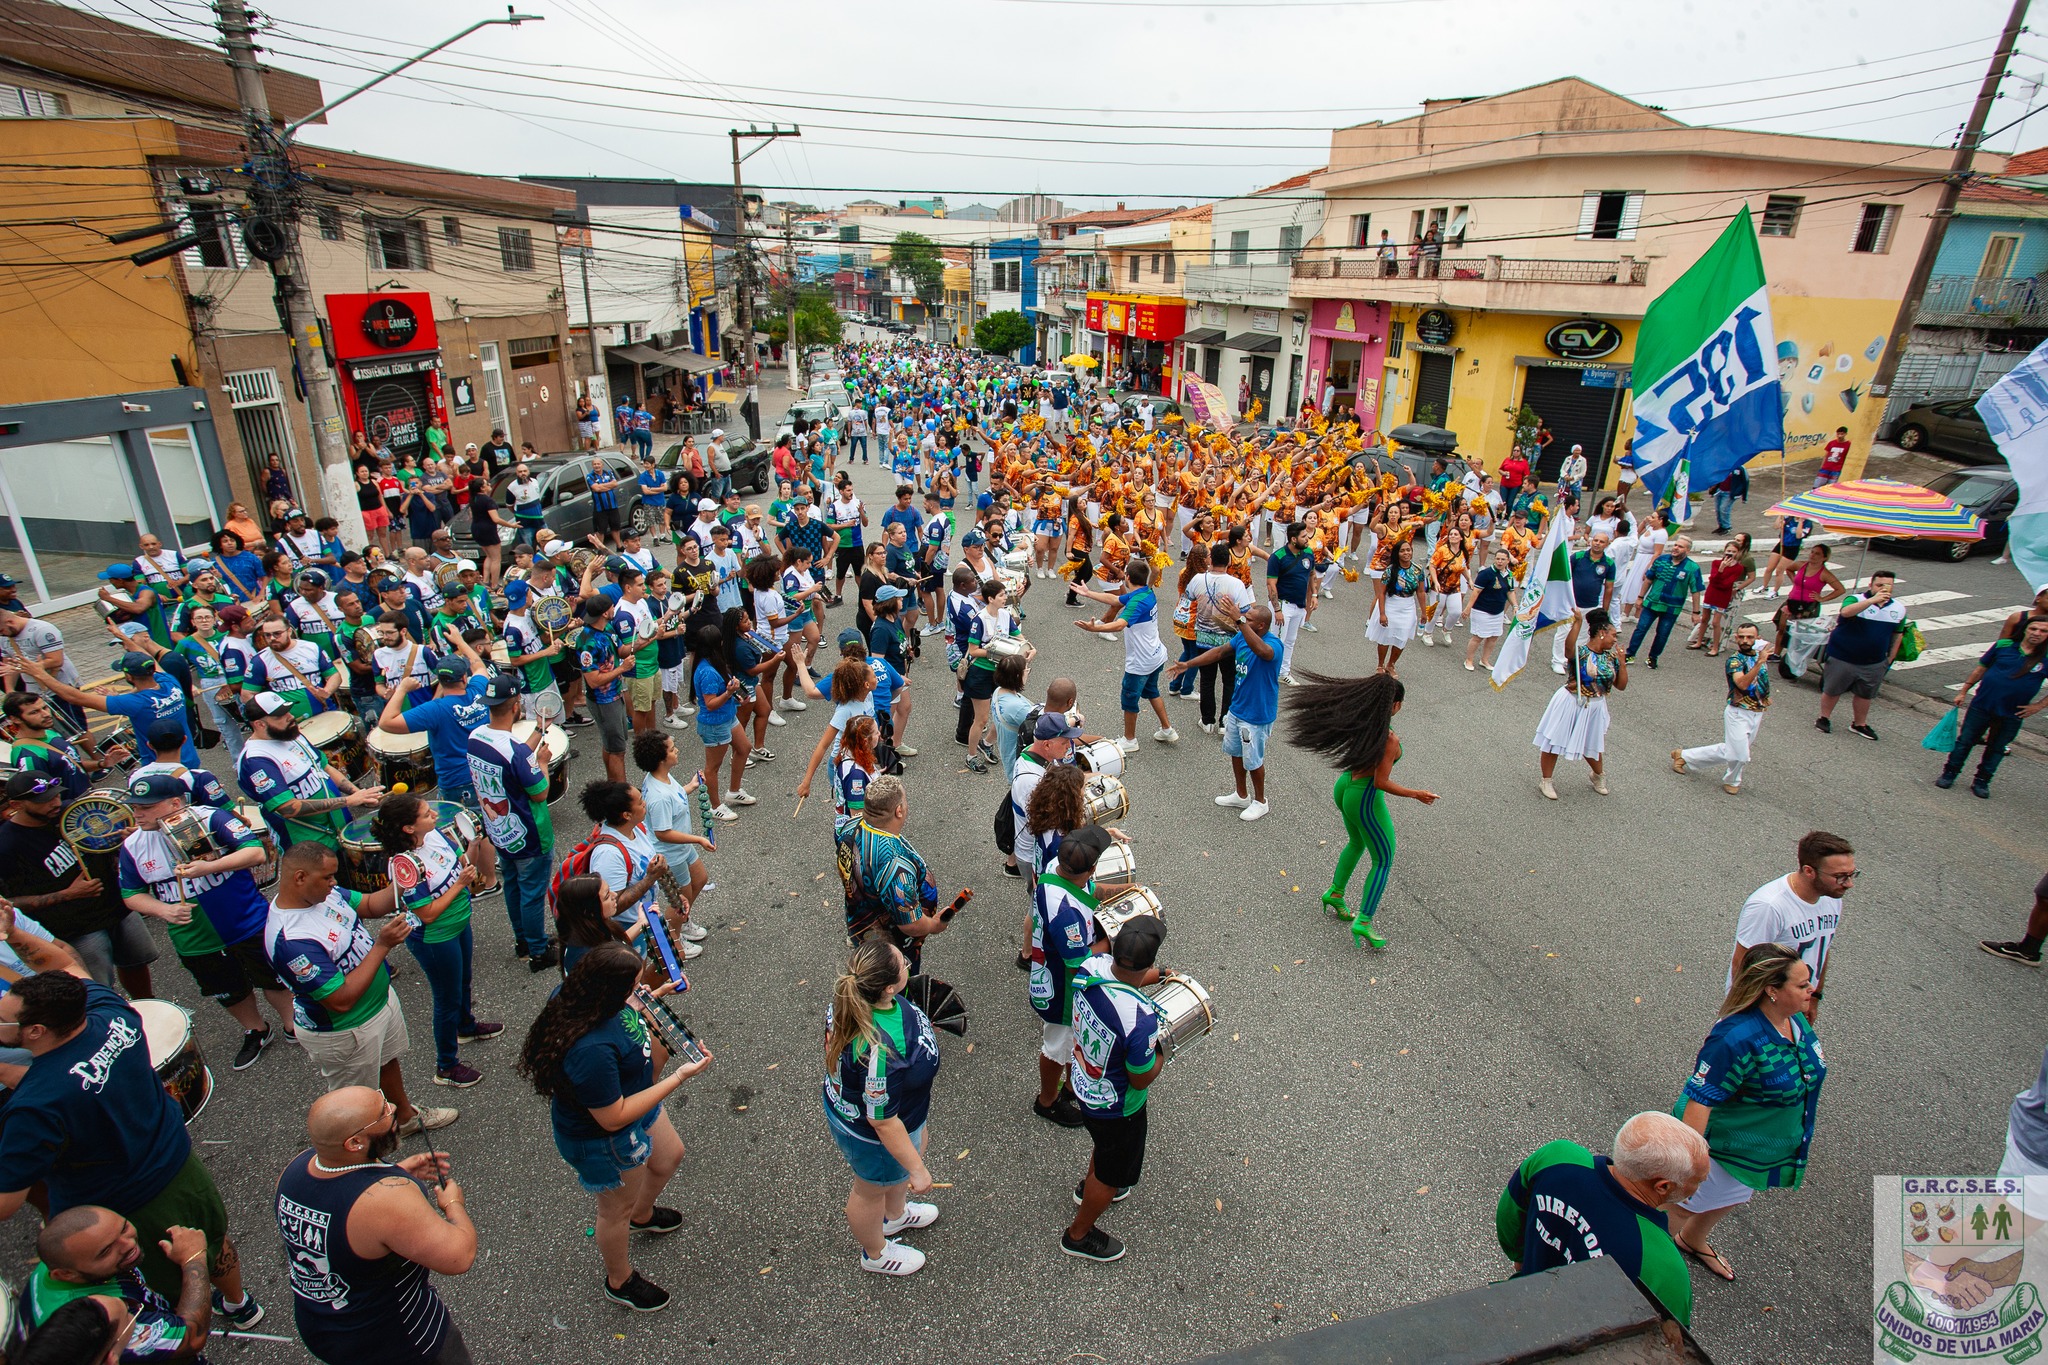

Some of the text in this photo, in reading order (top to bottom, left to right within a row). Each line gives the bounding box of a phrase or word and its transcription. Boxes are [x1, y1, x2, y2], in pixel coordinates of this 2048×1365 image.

[1559, 329, 1608, 347] GV
[418, 360, 435, 371] APPLE
[1562, 360, 1607, 369] 2362-0199
[1591, 370, 1616, 379] Byington
[391, 423, 417, 436] GAMES
[393, 433, 418, 447] CELULAR
[501, 829, 520, 844] MARIA
[1791, 919, 1815, 939] VILA
[1765, 1072, 1790, 1086] ELIANE
[280, 1198, 327, 1225] G.R.C.S.E.S.
[1536, 1218, 1561, 1251] VILA
